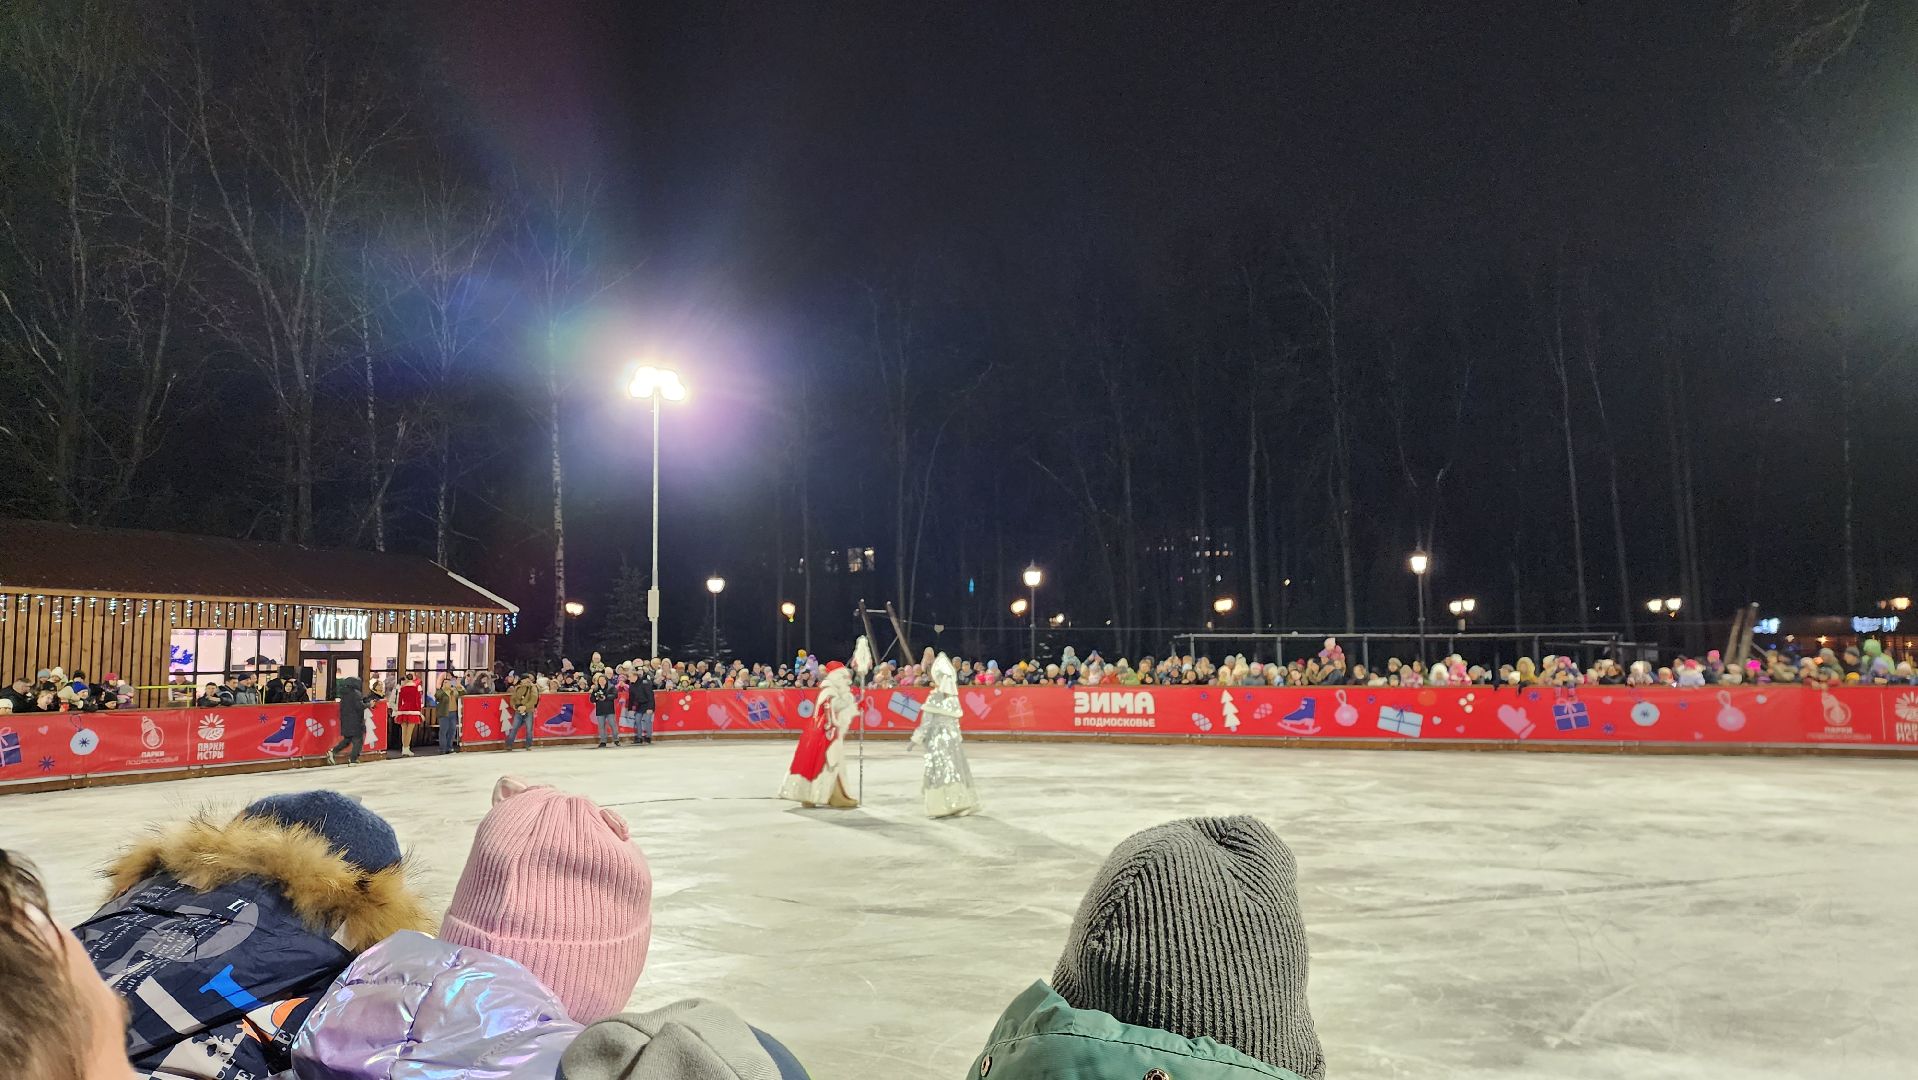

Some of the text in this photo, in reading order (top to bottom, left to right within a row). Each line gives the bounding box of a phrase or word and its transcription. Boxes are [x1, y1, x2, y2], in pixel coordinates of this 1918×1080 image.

[313, 613, 369, 640] КАТОК
[1073, 691, 1156, 715] ЗИМА
[1074, 717, 1156, 728] В ПОДМОСКОВЬЕ
[197, 741, 225, 752] ПАРКИ
[197, 749, 225, 761] ИСТРЫ
